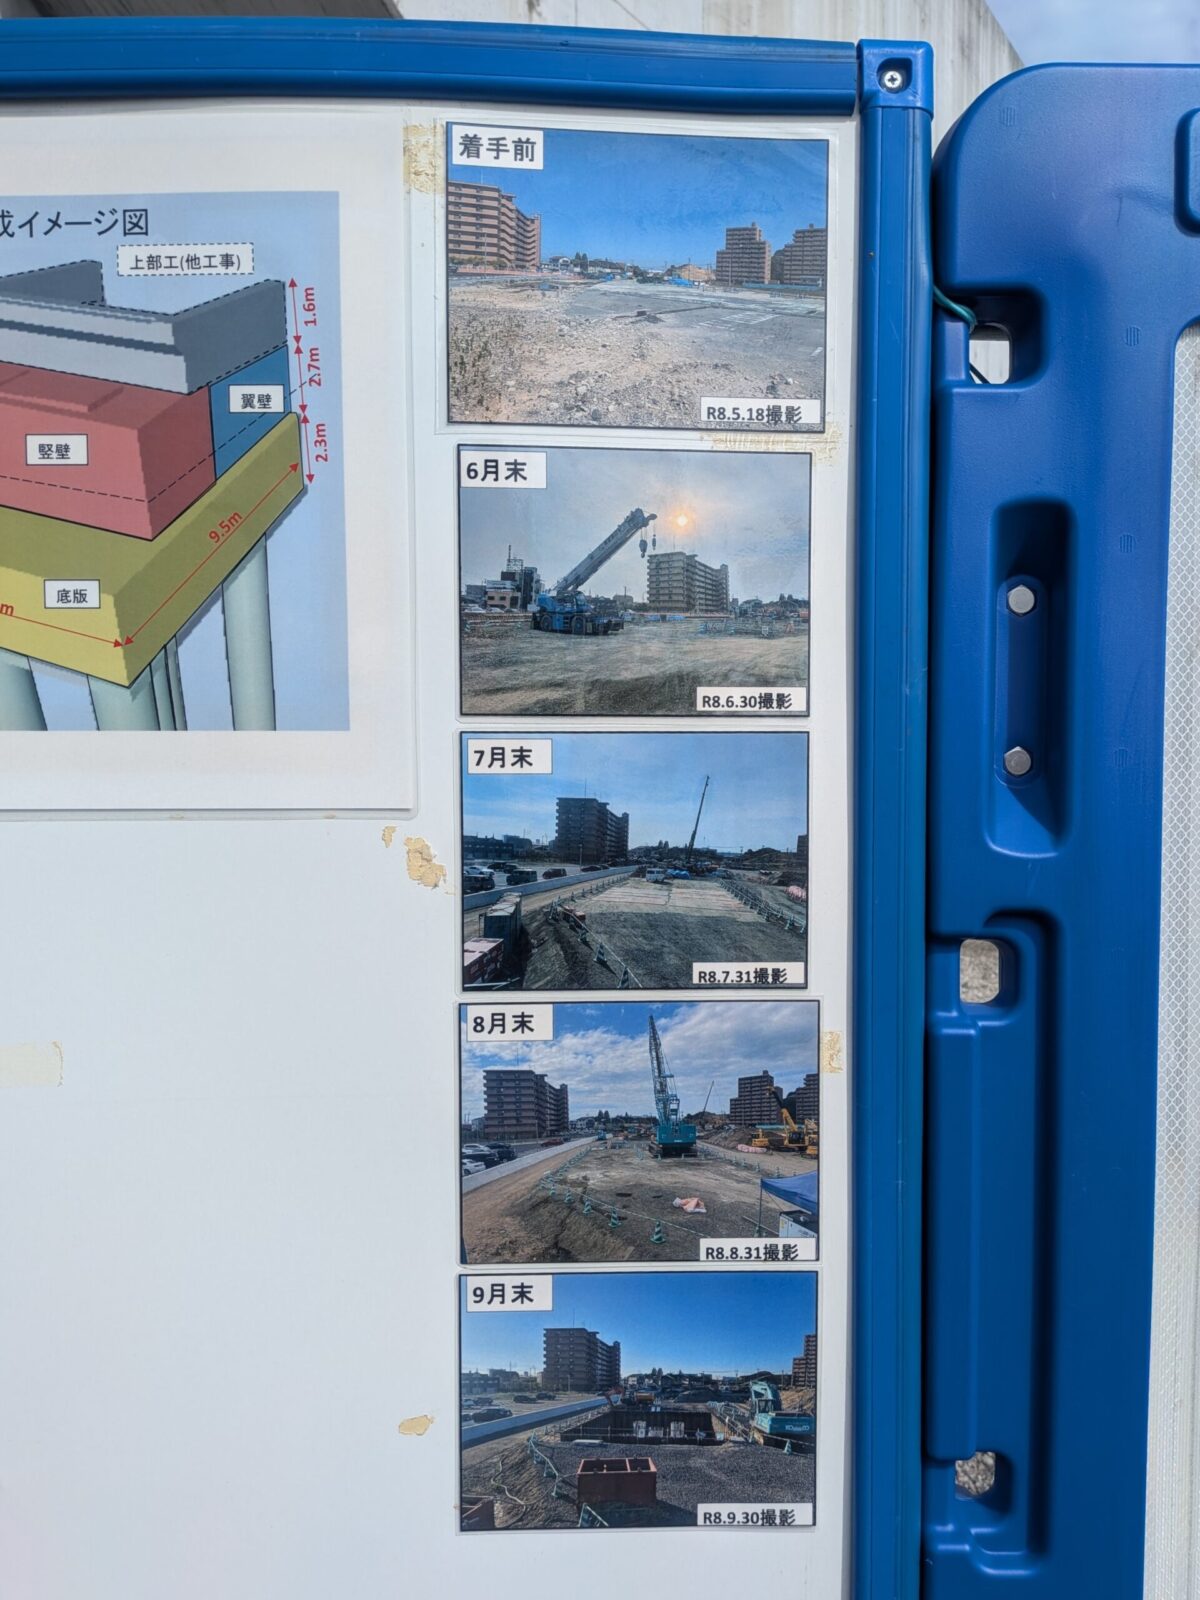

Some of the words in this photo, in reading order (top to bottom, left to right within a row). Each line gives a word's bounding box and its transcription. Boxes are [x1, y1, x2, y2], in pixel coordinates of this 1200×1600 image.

[459, 134, 537, 162] 着手前
[130, 253, 241, 271] 上部工(他工事)
[304, 287, 317, 327] 1.6m
[308, 347, 320, 387] 2.7m
[241, 393, 272, 409] 翼壁
[706, 405, 802, 424] R8.5.18撮影
[38, 443, 71, 460] 竪壁
[314, 423, 328, 462] 2.3m
[466, 459, 528, 482] 6月末
[208, 510, 243, 544] 9.5m
[56, 588, 88, 604] 底版
[702, 692, 792, 710] R8.6.30撮影
[474, 746, 533, 768] 7月末
[698, 968, 788, 984] R8.7.31撮影
[472, 1012, 534, 1034] 8月末
[706, 1244, 799, 1260] R8.8.31撮影
[472, 1282, 534, 1304] 9月末
[703, 1509, 796, 1526] R8.9.30撮影
